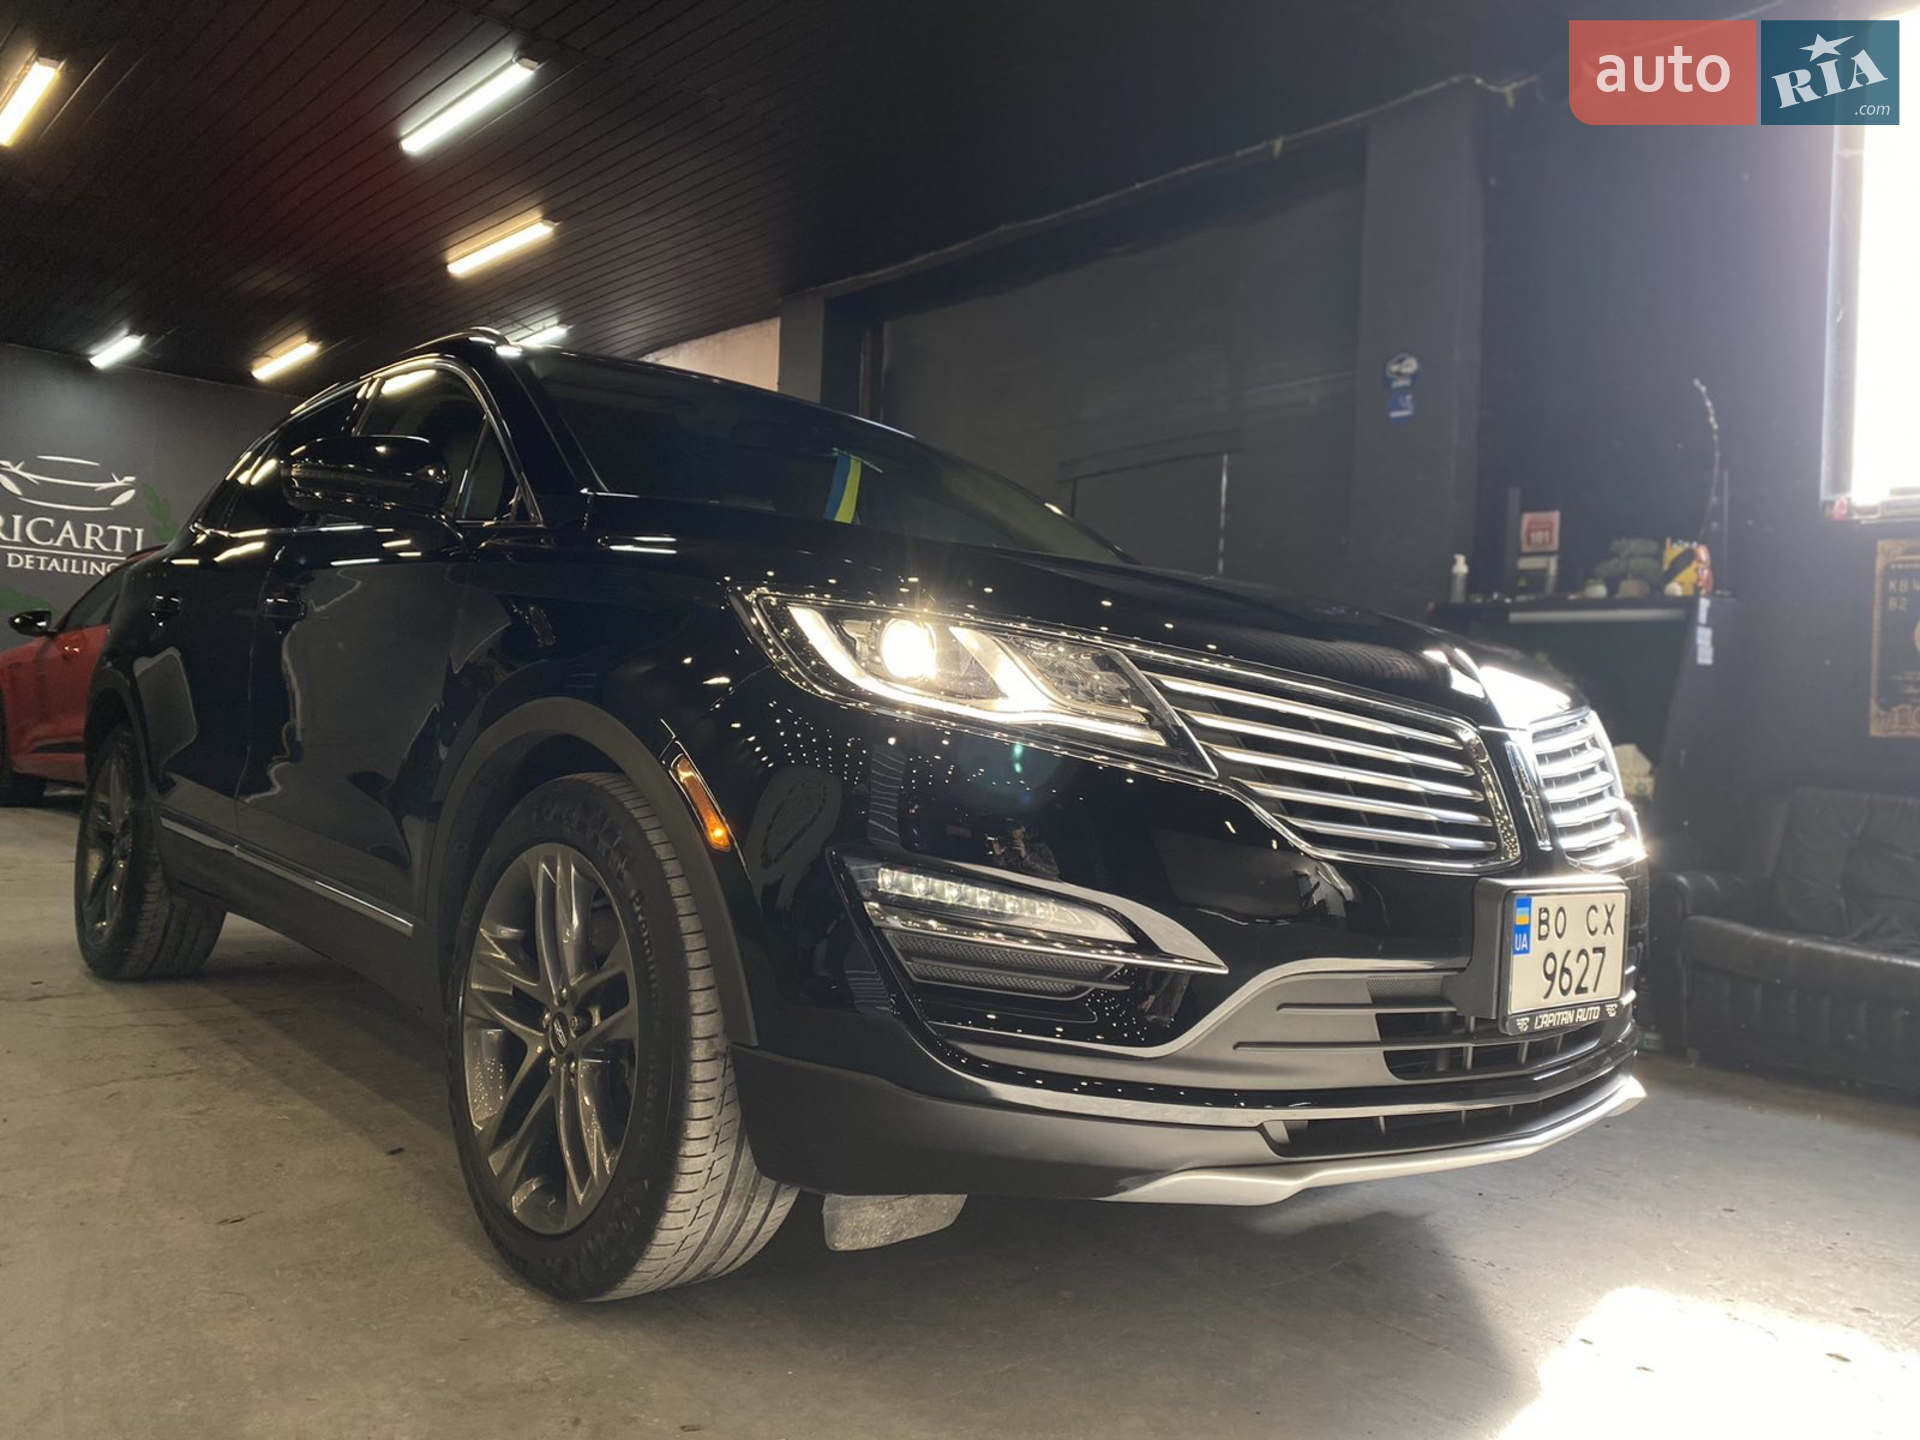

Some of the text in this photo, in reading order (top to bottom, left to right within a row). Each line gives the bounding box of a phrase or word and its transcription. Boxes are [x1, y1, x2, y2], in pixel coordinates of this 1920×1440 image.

[1586, 904, 1615, 936] CX
[1514, 933, 1528, 951] UA
[1542, 946, 1606, 1000] 9627
[1575, 1006, 1601, 1023] AUTO
